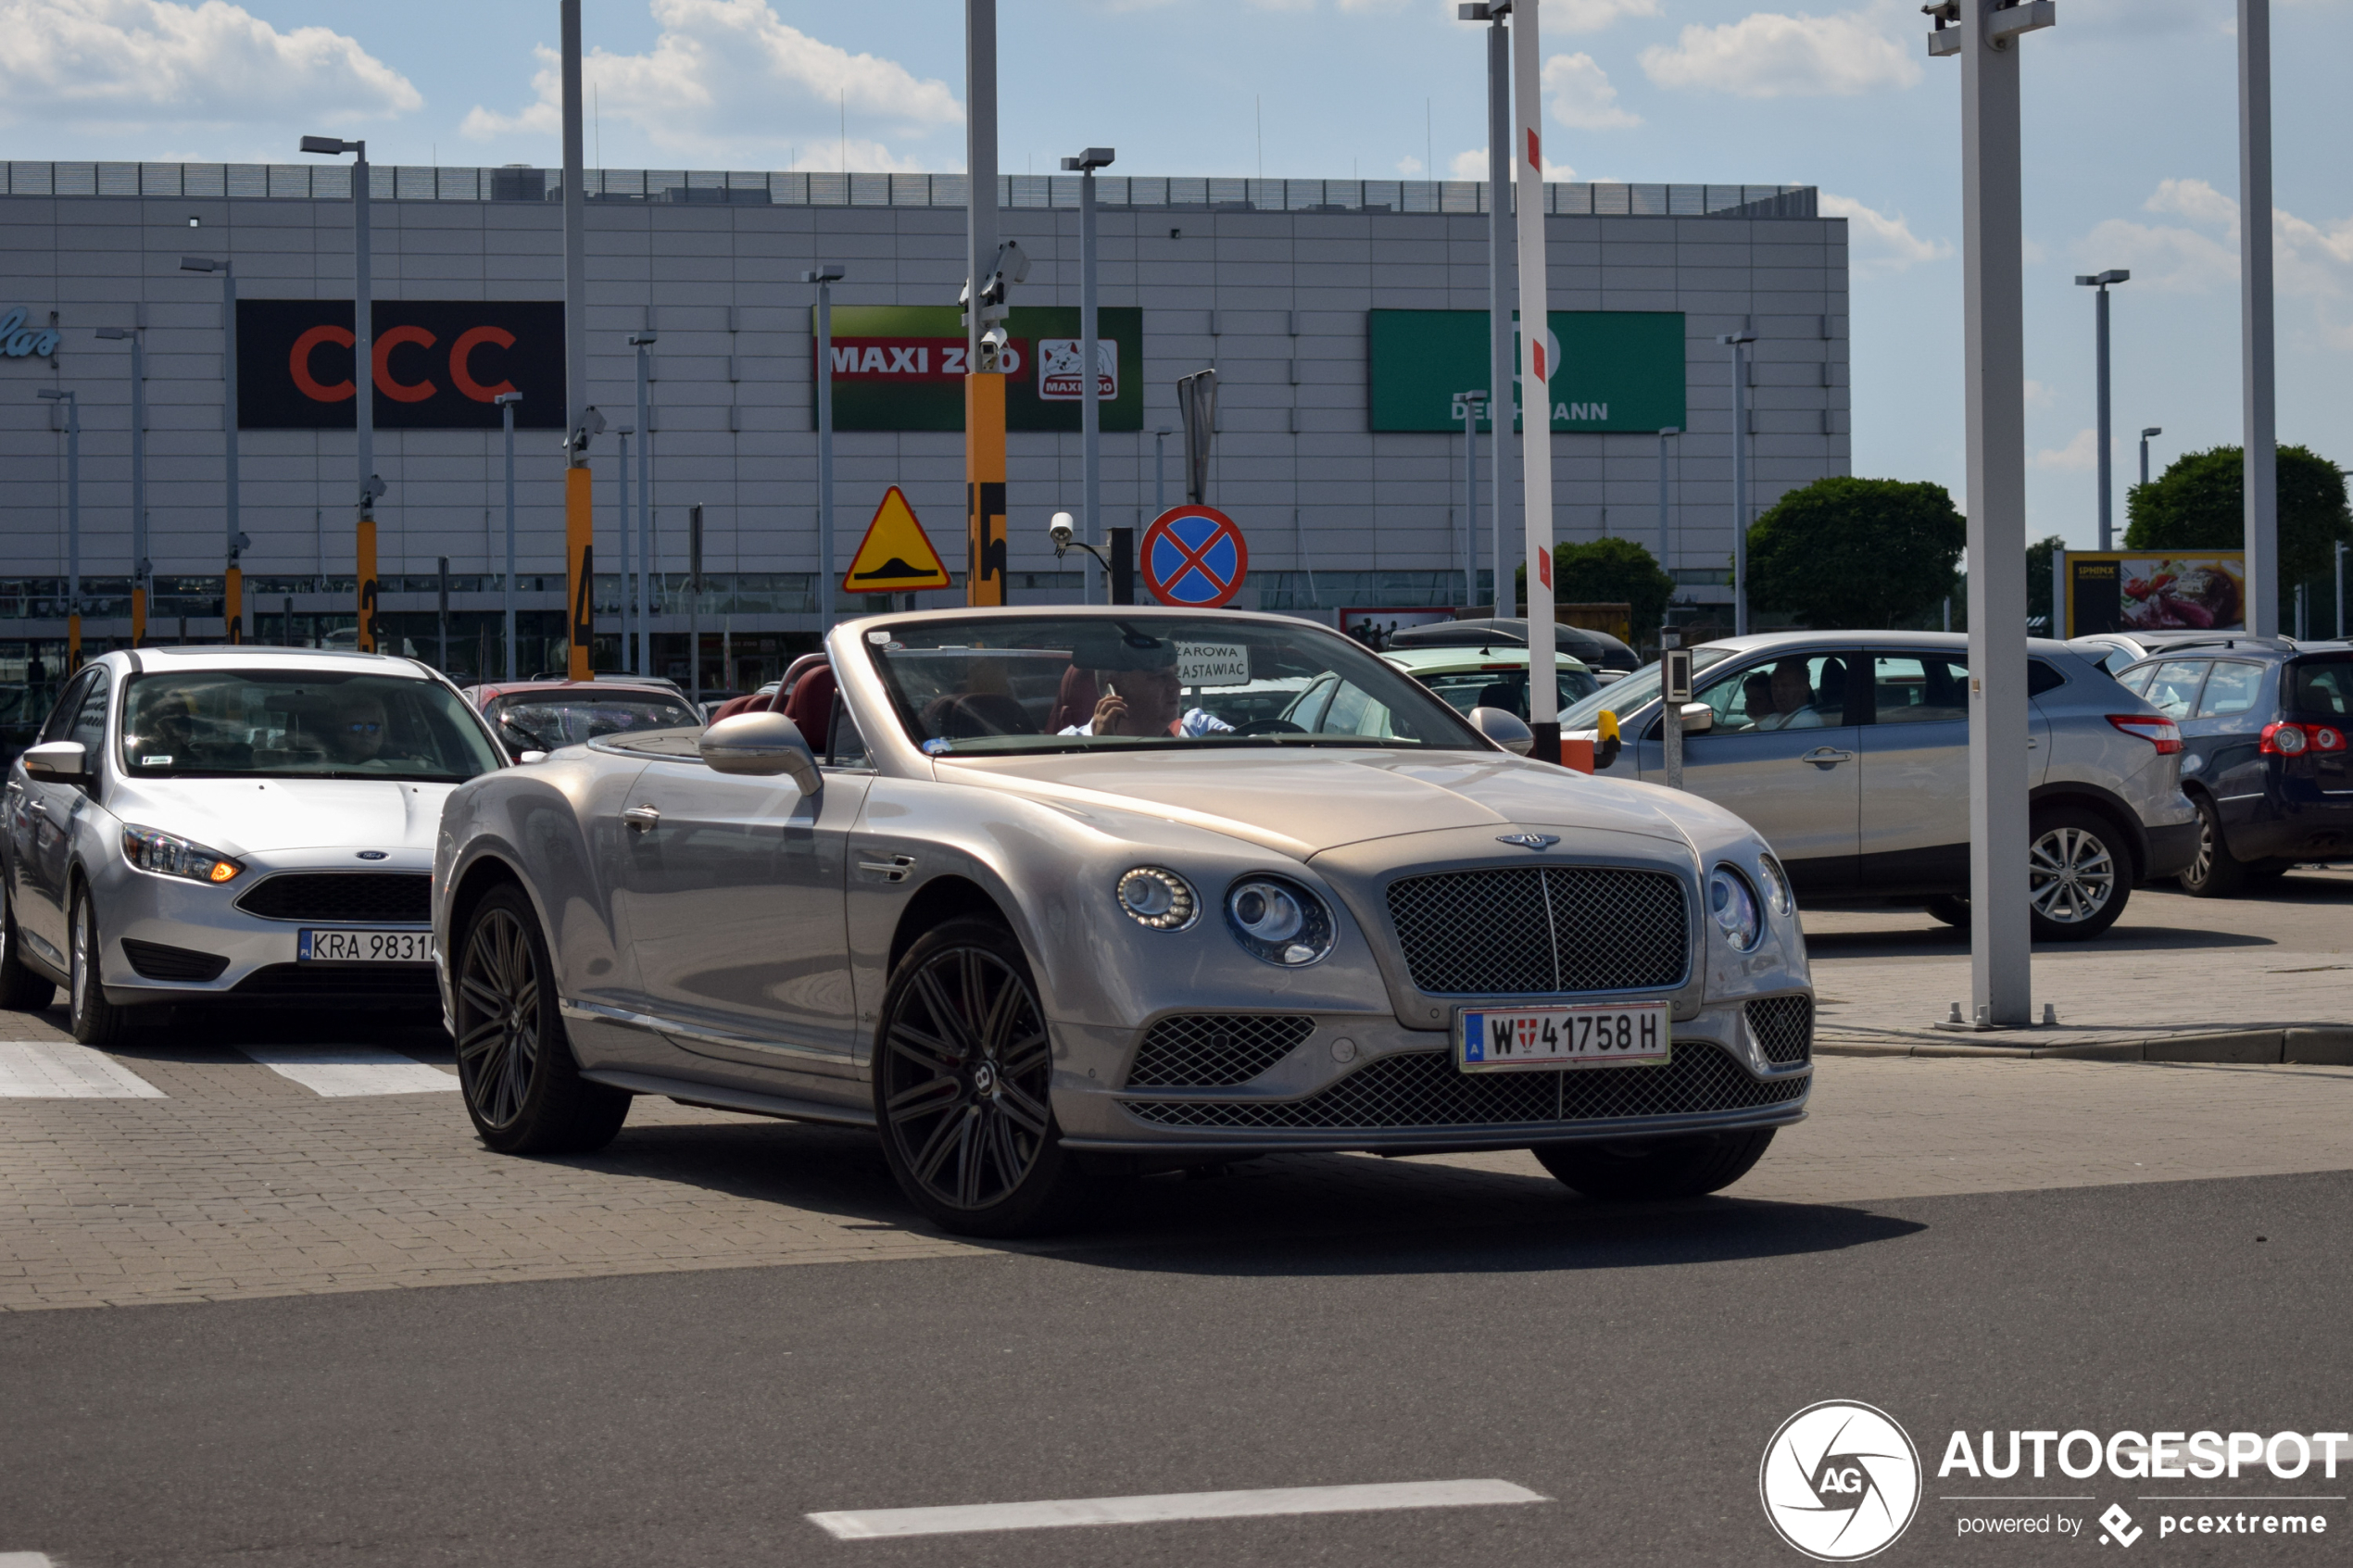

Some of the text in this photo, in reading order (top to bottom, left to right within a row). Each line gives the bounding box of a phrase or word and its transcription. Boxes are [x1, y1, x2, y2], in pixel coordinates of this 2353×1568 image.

[289, 325, 517, 403] CCC
[831, 345, 1020, 374] MAXI ZO
[1046, 383, 1082, 392] MAXI
[2078, 566, 2114, 574] SPHINX
[313, 934, 359, 959] KRA
[1470, 1044, 1479, 1055] A
[1492, 1019, 1514, 1055] W
